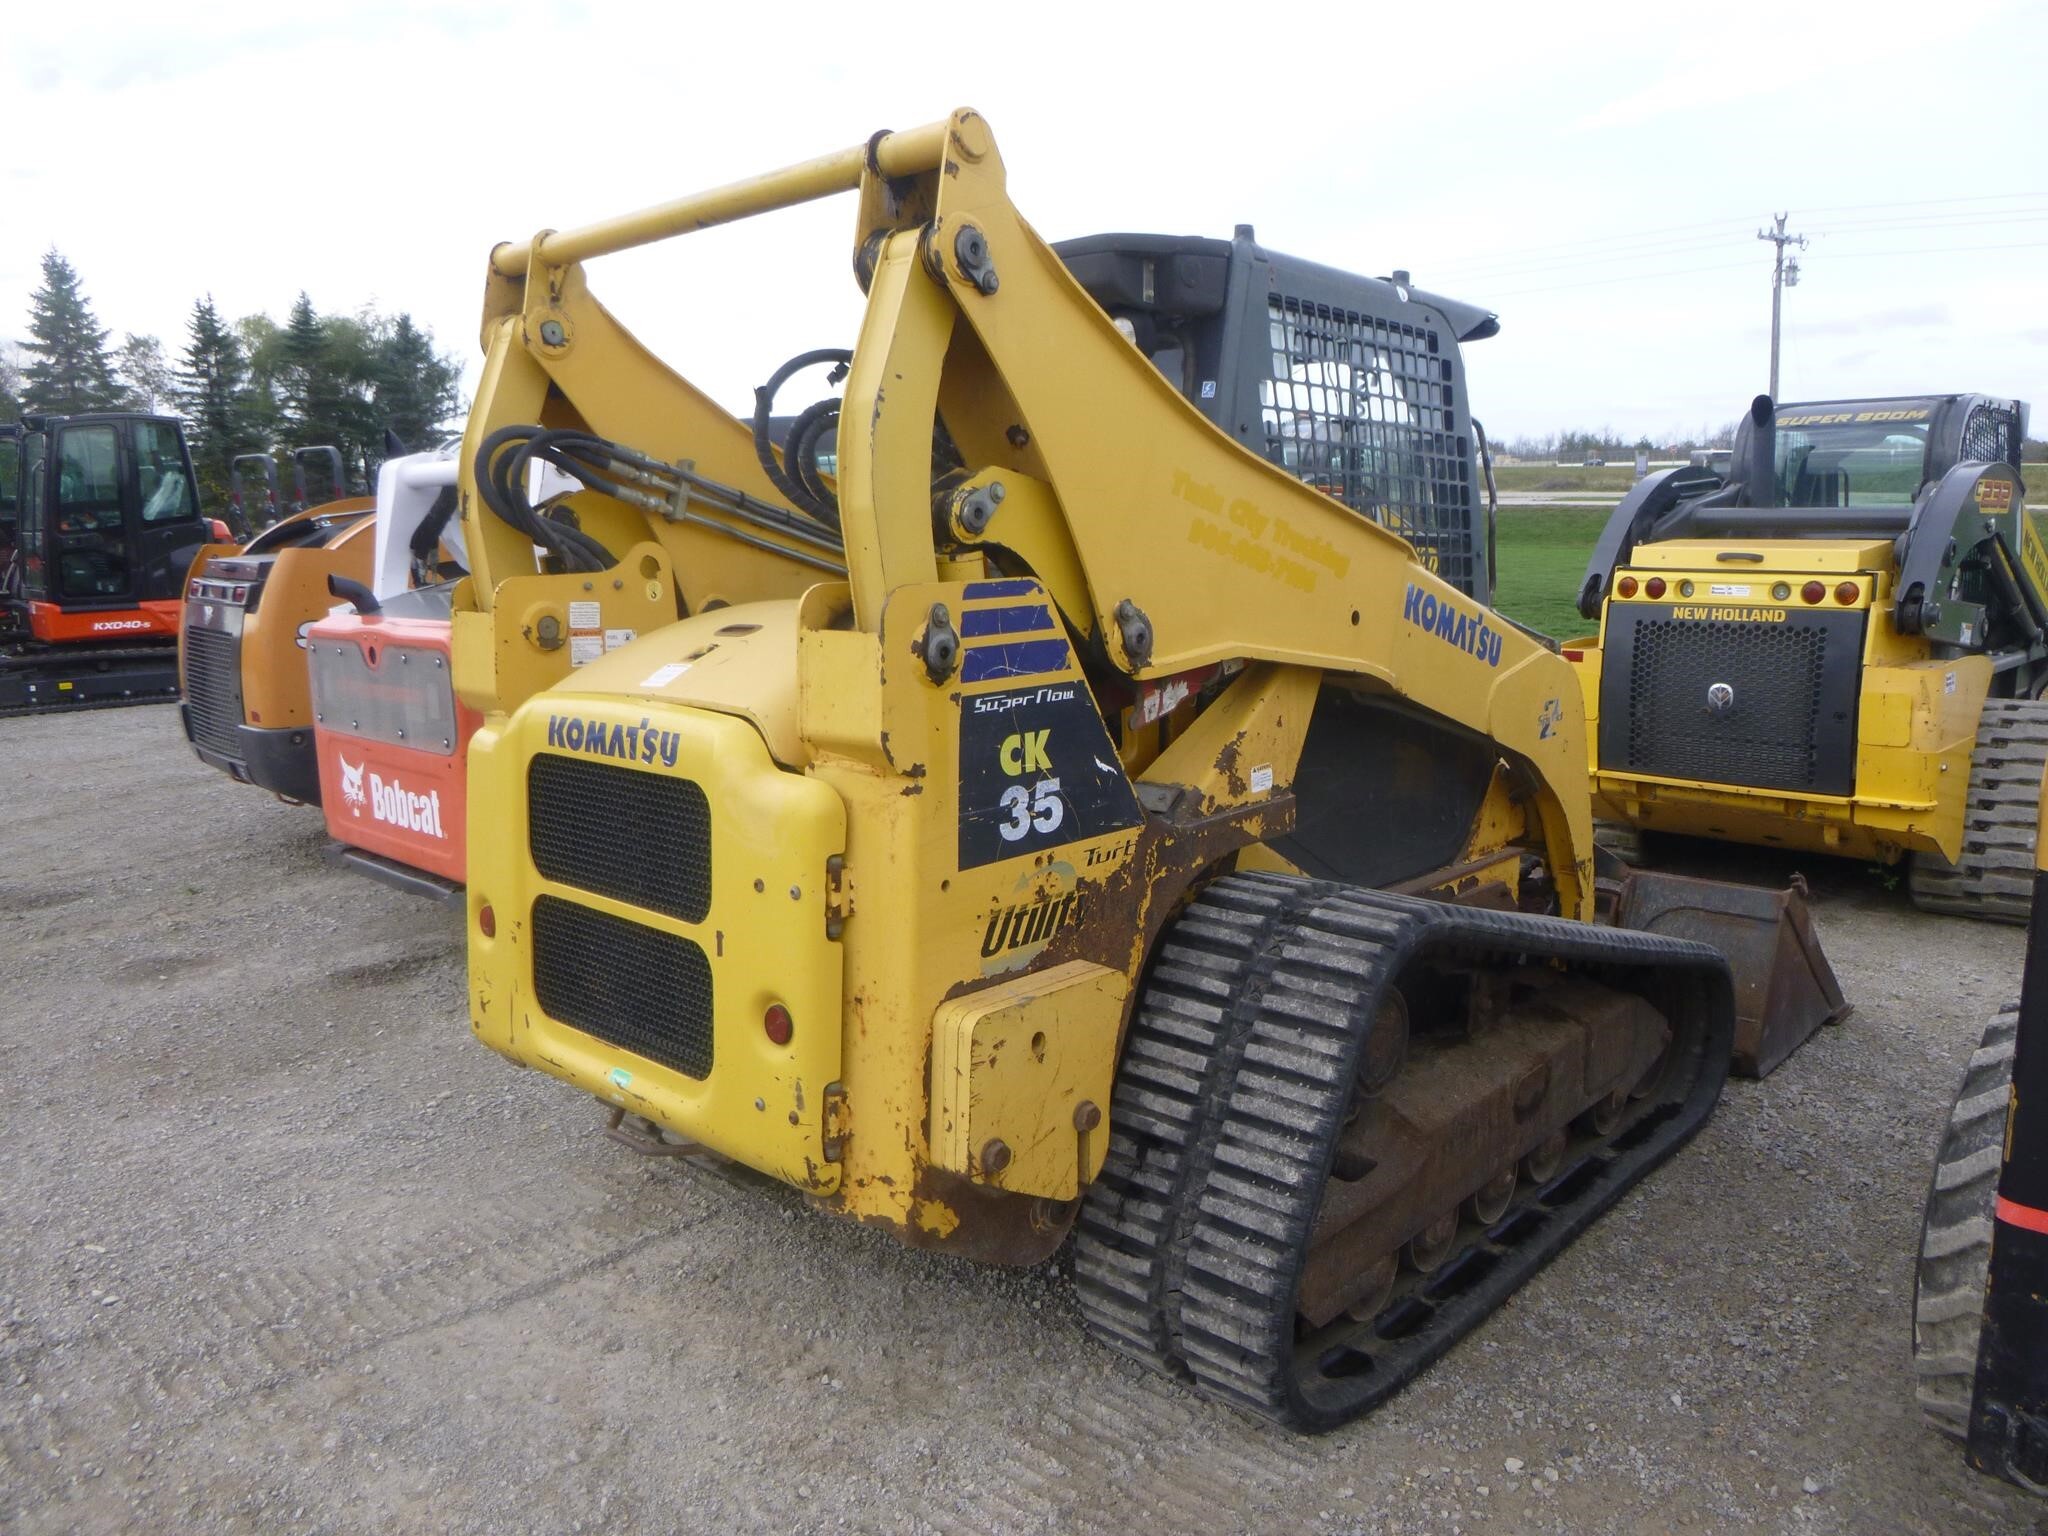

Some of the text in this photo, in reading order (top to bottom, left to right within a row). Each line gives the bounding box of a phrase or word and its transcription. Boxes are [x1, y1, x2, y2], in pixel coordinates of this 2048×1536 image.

[1776, 410, 1929, 426] SUPER BOOM
[1403, 582, 1503, 667] KOMATSU
[1672, 607, 1786, 622] NEW HOLLAND
[548, 714, 681, 767] KOMATSU
[999, 728, 1052, 777] CK
[369, 773, 443, 839] Bobcat
[999, 776, 1064, 842] 35
